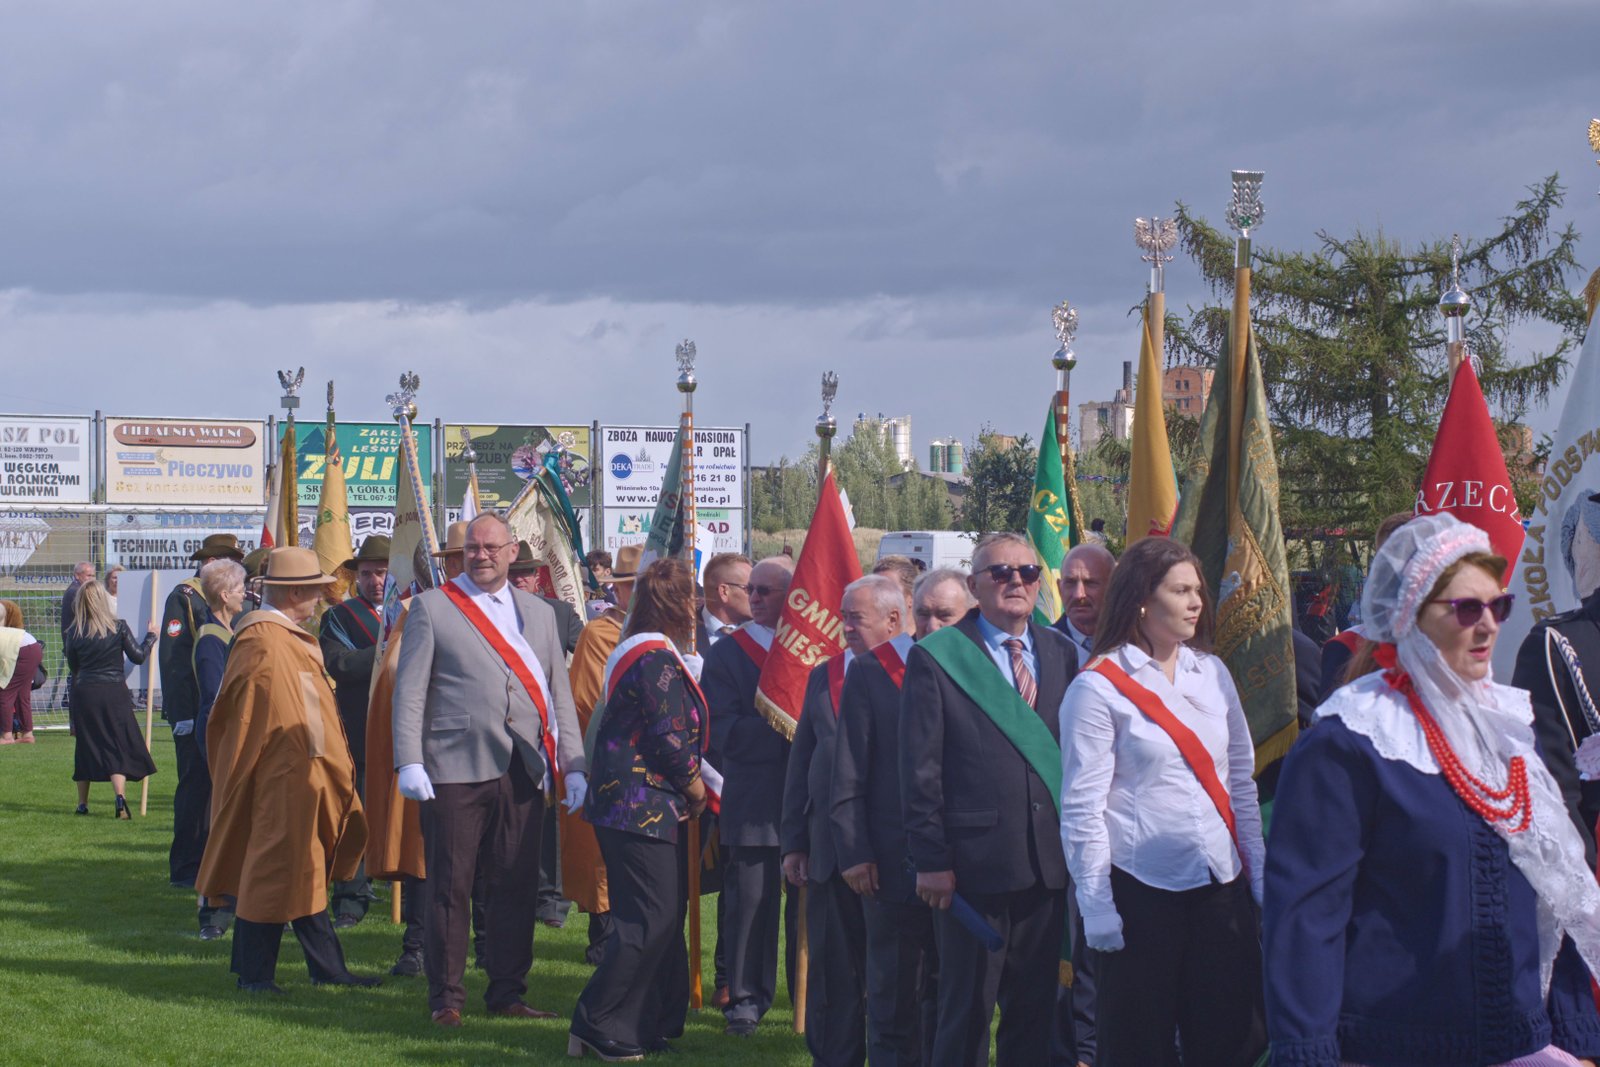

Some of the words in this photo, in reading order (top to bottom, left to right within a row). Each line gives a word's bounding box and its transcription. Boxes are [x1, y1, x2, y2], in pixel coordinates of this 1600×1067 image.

[39, 428, 80, 445] POL
[360, 428, 419, 438] ZAKŁD
[608, 429, 638, 442] ZBOŻA
[694, 432, 735, 444] NASIONA
[500, 442, 513, 450] NA
[713, 447, 736, 458] OPAŁ
[168, 461, 253, 479] Pieczywo
[611, 462, 632, 472] DEKA
[7, 474, 80, 485] ROLNICZYMI
[710, 475, 721, 483] 21
[724, 475, 737, 483] 80
[357, 485, 387, 496] GÓRA
[112, 537, 178, 554] TECHNIKA
